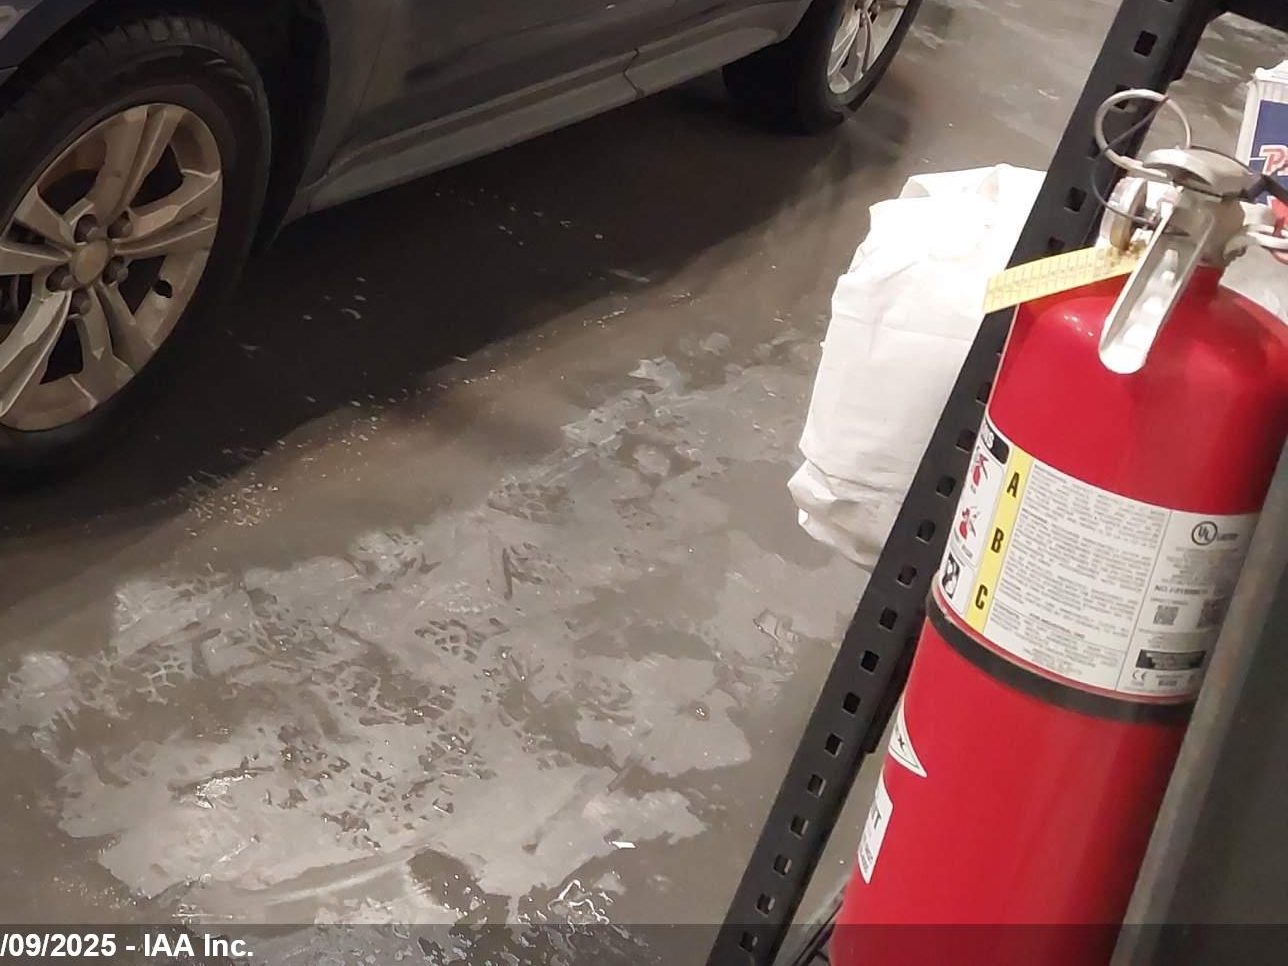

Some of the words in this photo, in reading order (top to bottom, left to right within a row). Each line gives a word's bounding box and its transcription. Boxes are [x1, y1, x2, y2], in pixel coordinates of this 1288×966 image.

[1006, 472, 1020, 498] A
[990, 527, 1005, 553] B
[975, 584, 988, 610] C
